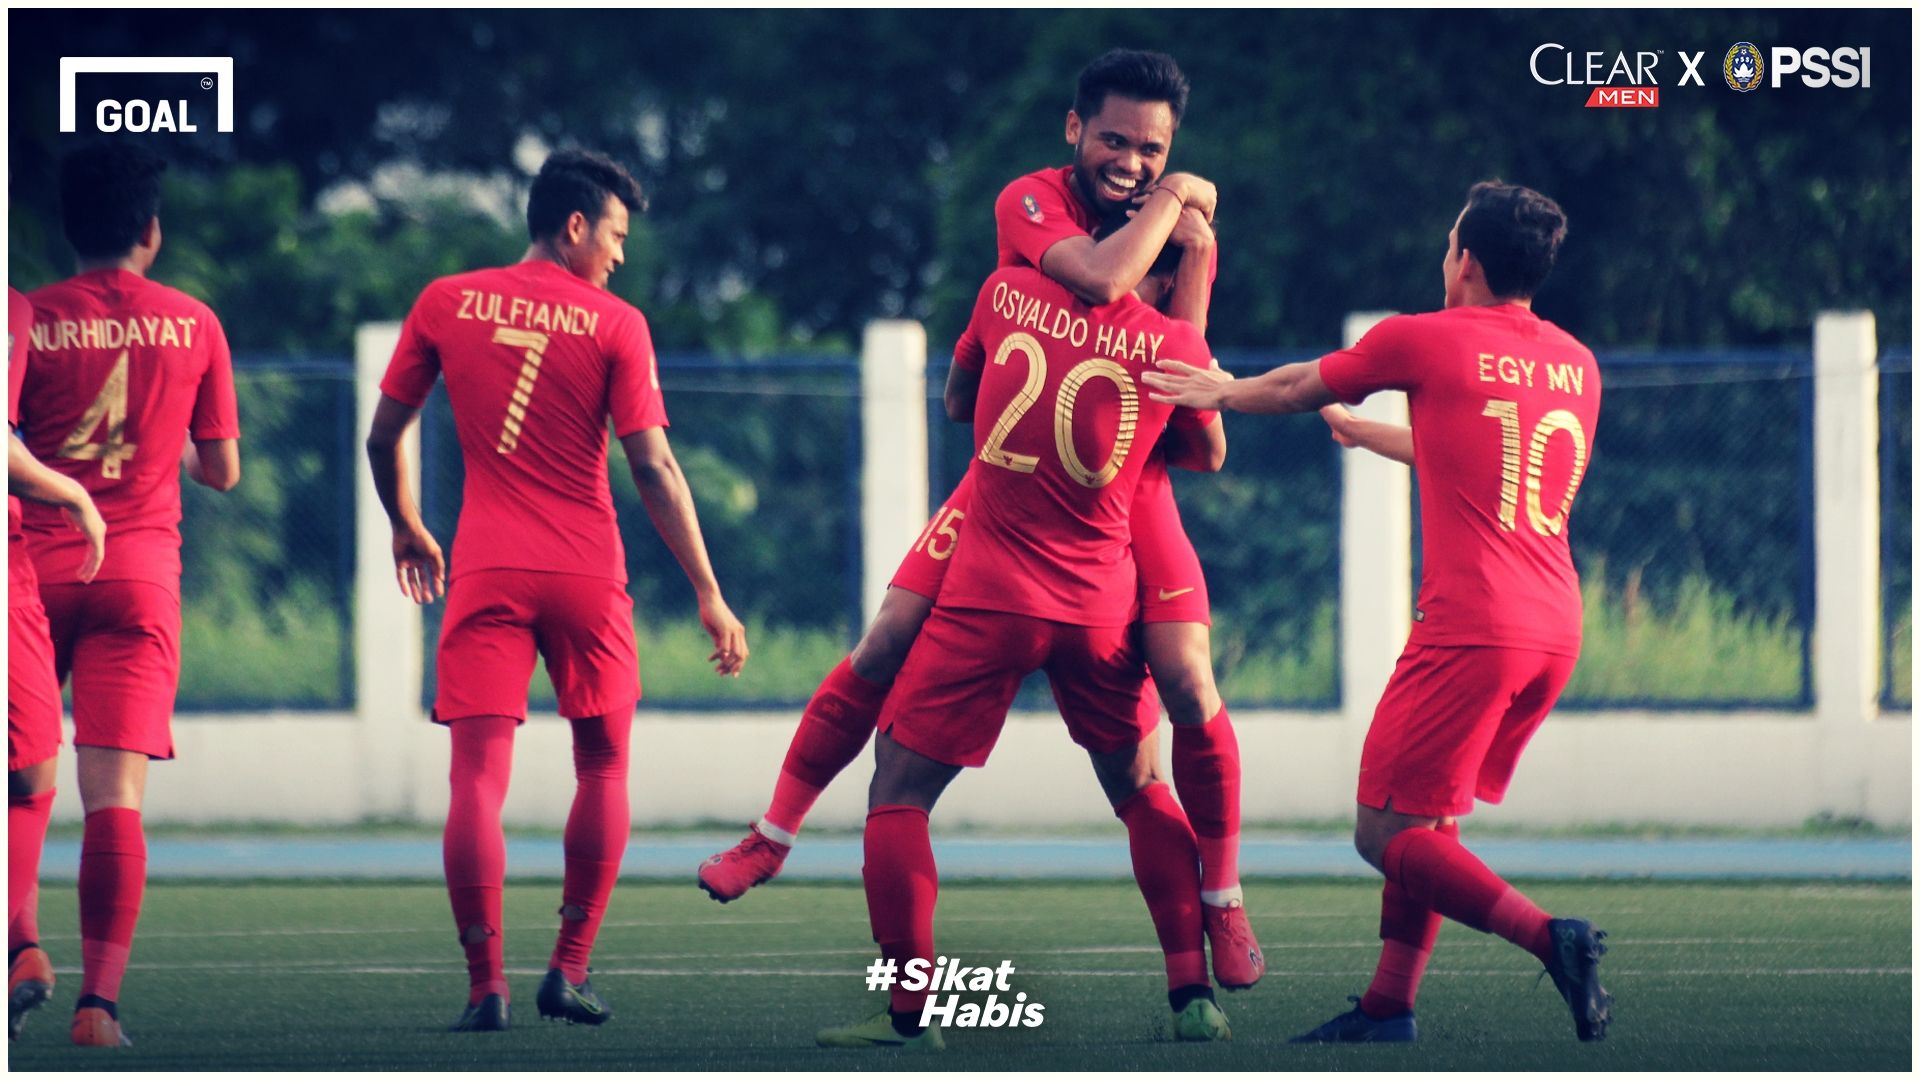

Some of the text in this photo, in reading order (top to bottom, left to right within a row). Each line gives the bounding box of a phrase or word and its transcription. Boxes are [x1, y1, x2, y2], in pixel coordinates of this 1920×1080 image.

[29, 316, 196, 351] NURHIDAYAT
[457, 289, 599, 337] ZULFIANDI
[993, 281, 1164, 364] OSVALDO HAAY
[57, 349, 138, 480] 4
[491, 326, 550, 454] 7
[978, 331, 1139, 489] 20
[1479, 353, 1584, 396] EGY MV
[1481, 399, 1587, 537] 10
[915, 506, 965, 561] 15
